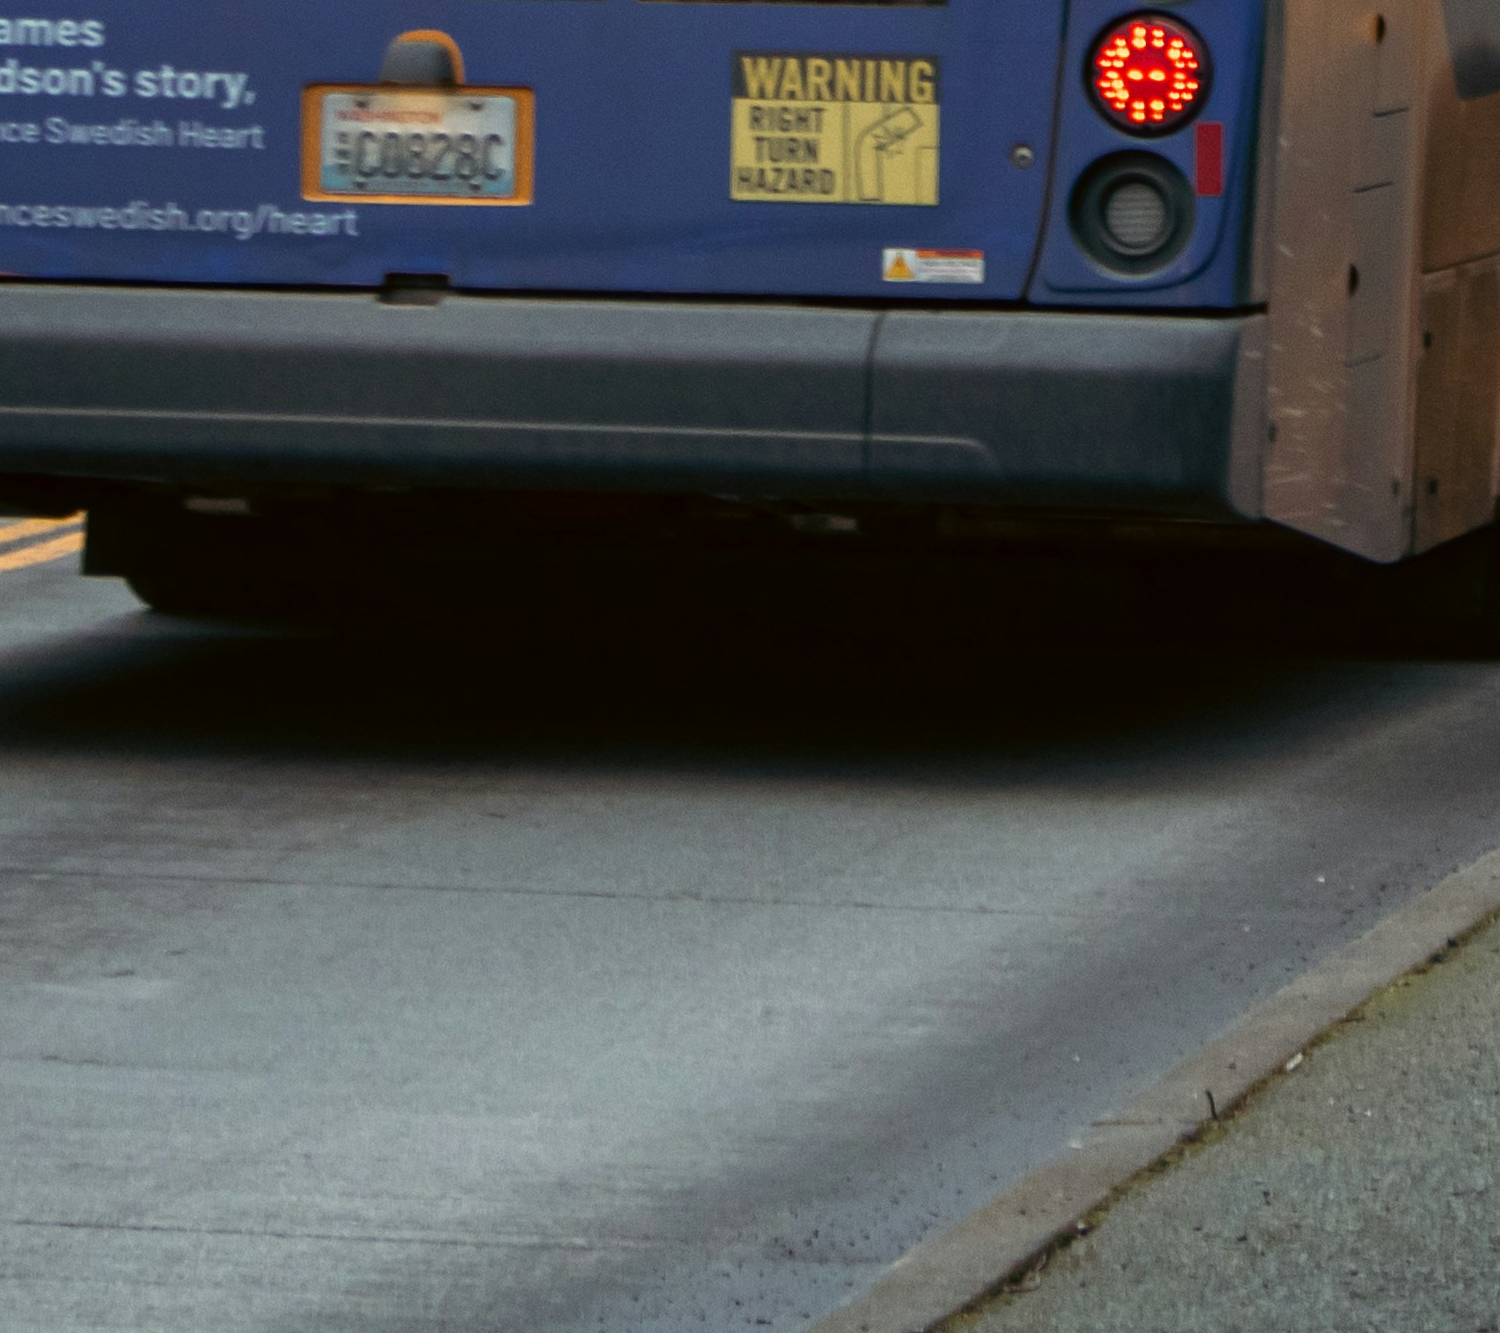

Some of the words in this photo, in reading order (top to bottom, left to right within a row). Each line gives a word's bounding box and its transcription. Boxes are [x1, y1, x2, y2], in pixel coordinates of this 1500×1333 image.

[136, 64, 257, 110] story,
[741, 57, 935, 102] WARNING
[46, 117, 173, 148] Swedish
[180, 120, 265, 150] Heart
[749, 106, 826, 132] RIGHT
[754, 136, 820, 163] TURN
[736, 166, 835, 194] HAZARD
